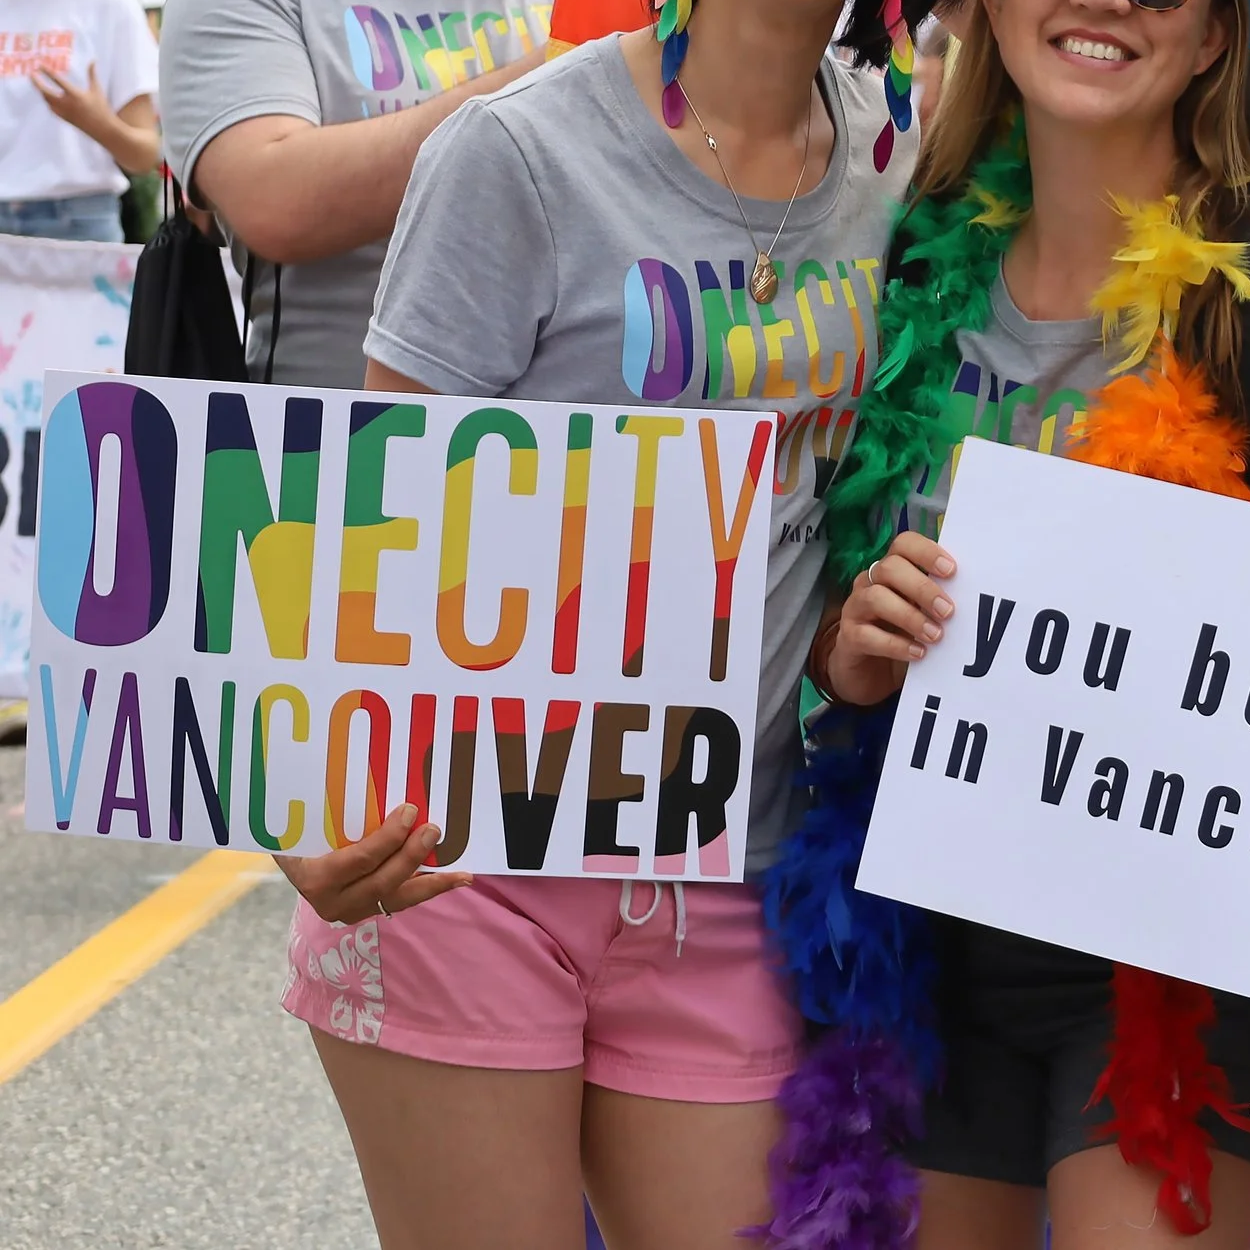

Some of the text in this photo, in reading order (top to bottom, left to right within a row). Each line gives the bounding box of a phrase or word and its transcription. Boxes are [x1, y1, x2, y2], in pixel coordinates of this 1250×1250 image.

[36, 381, 773, 683] ONECITY
[962, 592, 1131, 691] you
[40, 662, 742, 876] VANCOUVER
[909, 695, 989, 784] in
